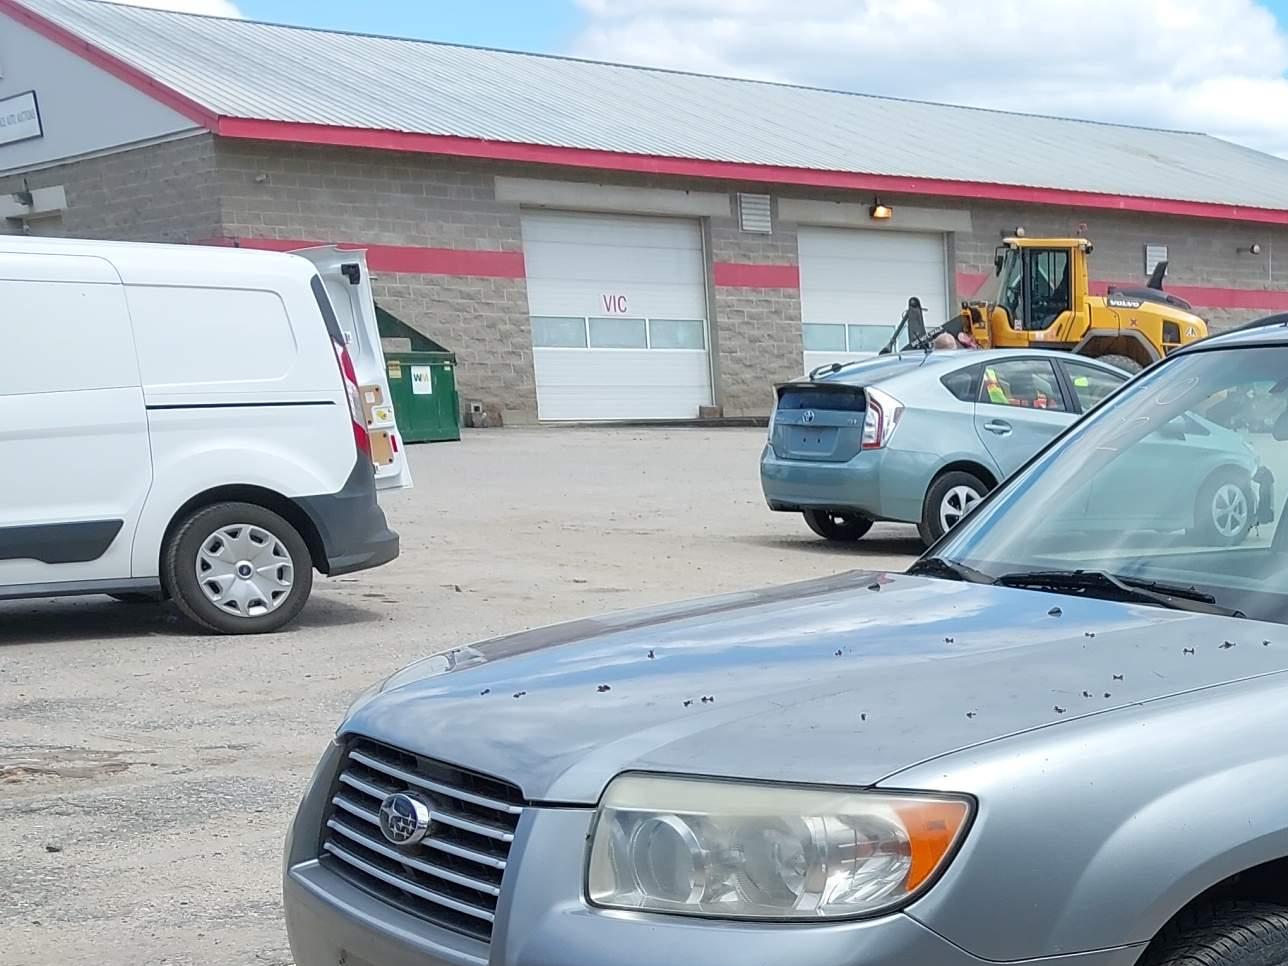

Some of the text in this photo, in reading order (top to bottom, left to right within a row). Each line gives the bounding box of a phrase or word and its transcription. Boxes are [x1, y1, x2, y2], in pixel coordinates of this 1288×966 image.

[602, 294, 628, 313] VIC
[1109, 299, 1140, 308] VOLVO
[413, 371, 429, 382] WM
